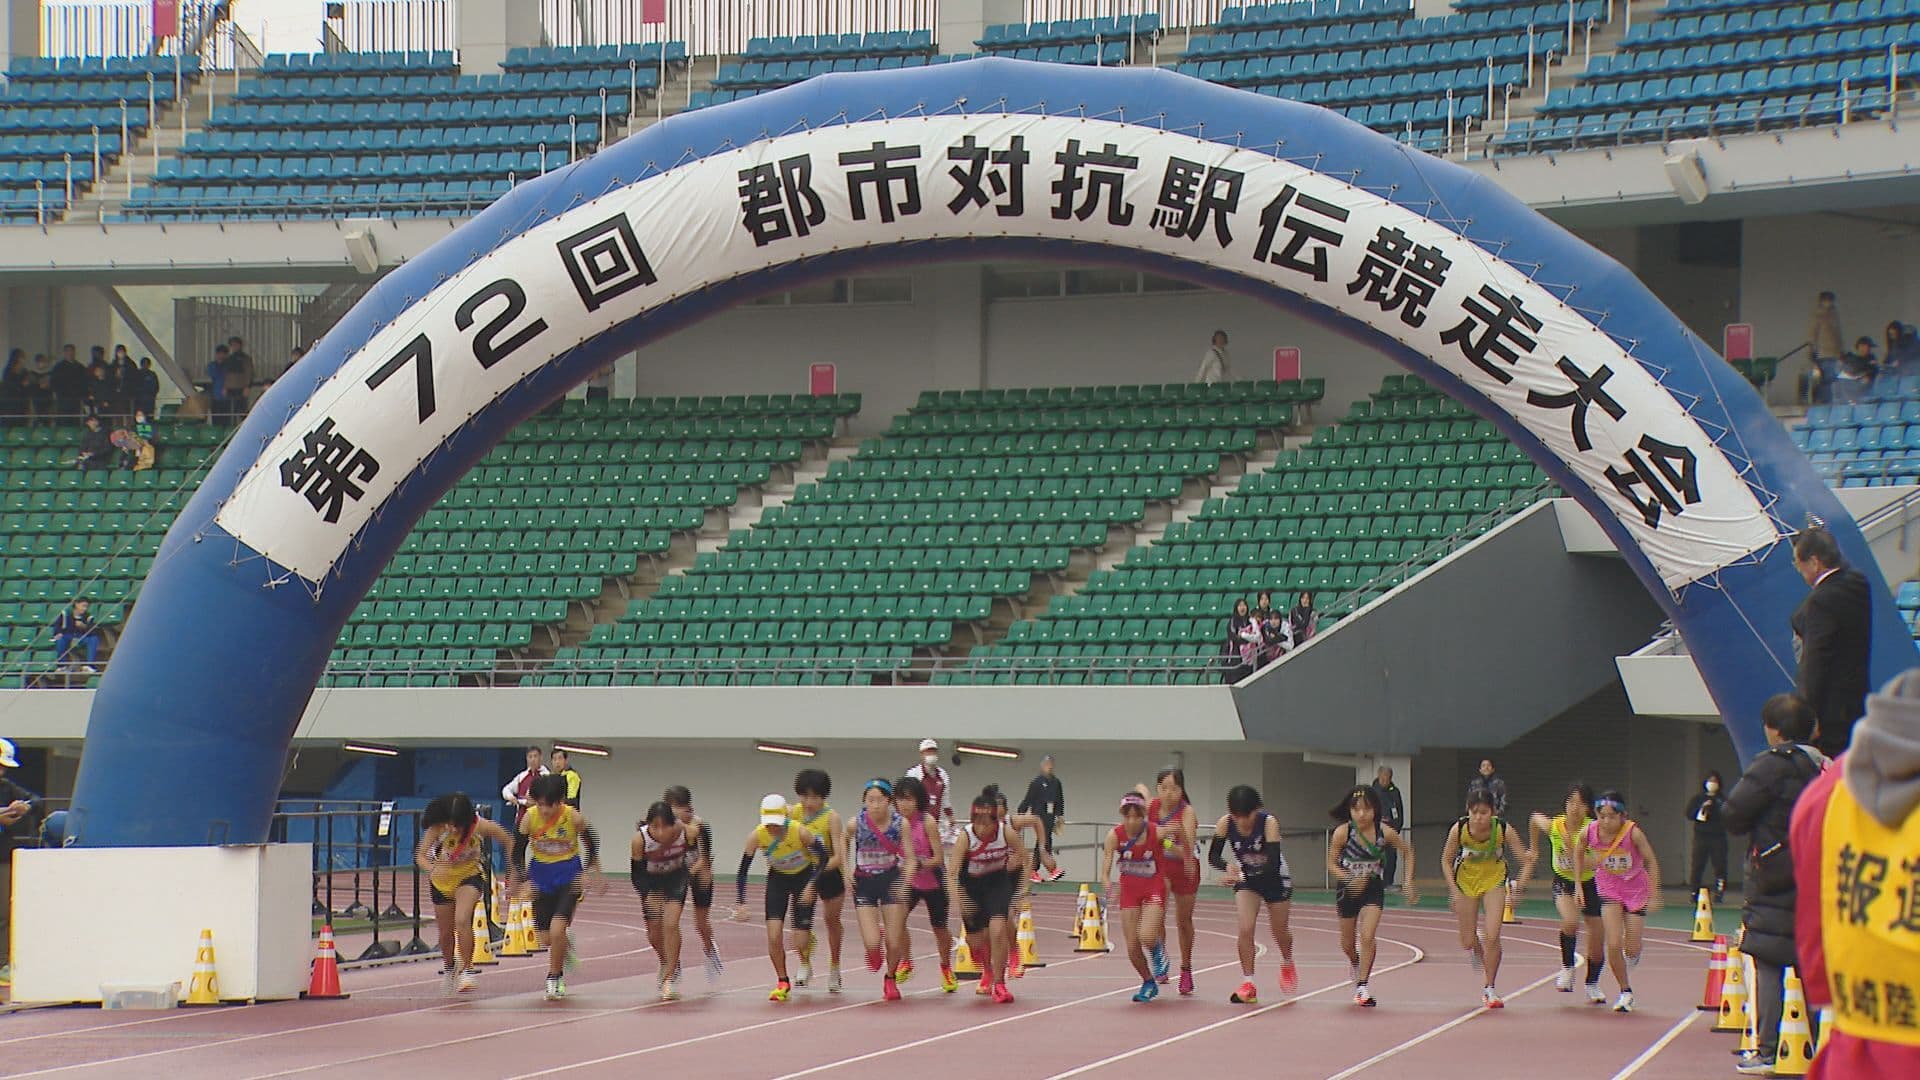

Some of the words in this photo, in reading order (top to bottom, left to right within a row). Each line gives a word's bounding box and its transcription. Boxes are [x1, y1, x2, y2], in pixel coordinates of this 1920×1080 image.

[280, 212, 658, 523] 第72回
[739, 138, 1702, 529] 郡市対抗駅伝競走大会
